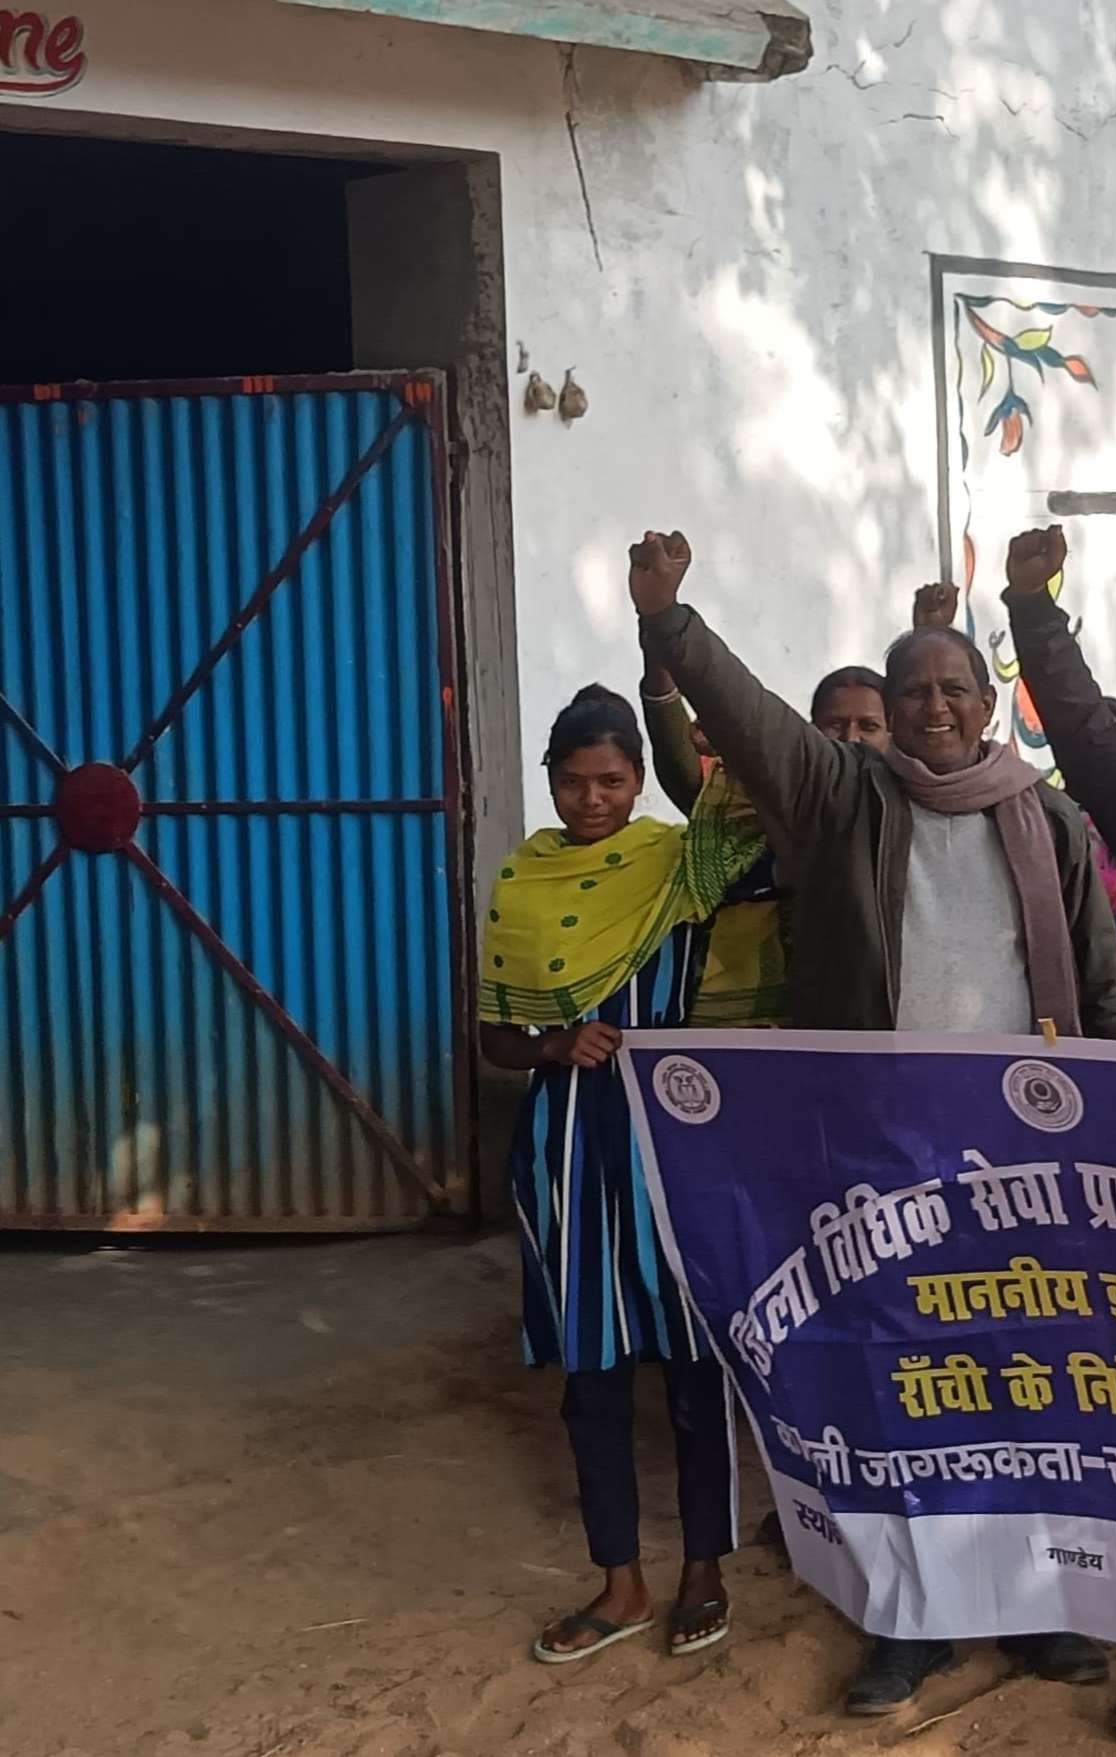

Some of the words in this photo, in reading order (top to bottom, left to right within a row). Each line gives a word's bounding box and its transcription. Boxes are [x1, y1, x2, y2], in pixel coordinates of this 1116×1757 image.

[810, 1177, 952, 1295] विधिक
[957, 1149, 1069, 1232] सेवा
[907, 1257, 1093, 1322] माननीय
[891, 1354, 993, 1418] राँची
[1000, 1352, 1054, 1412] के
